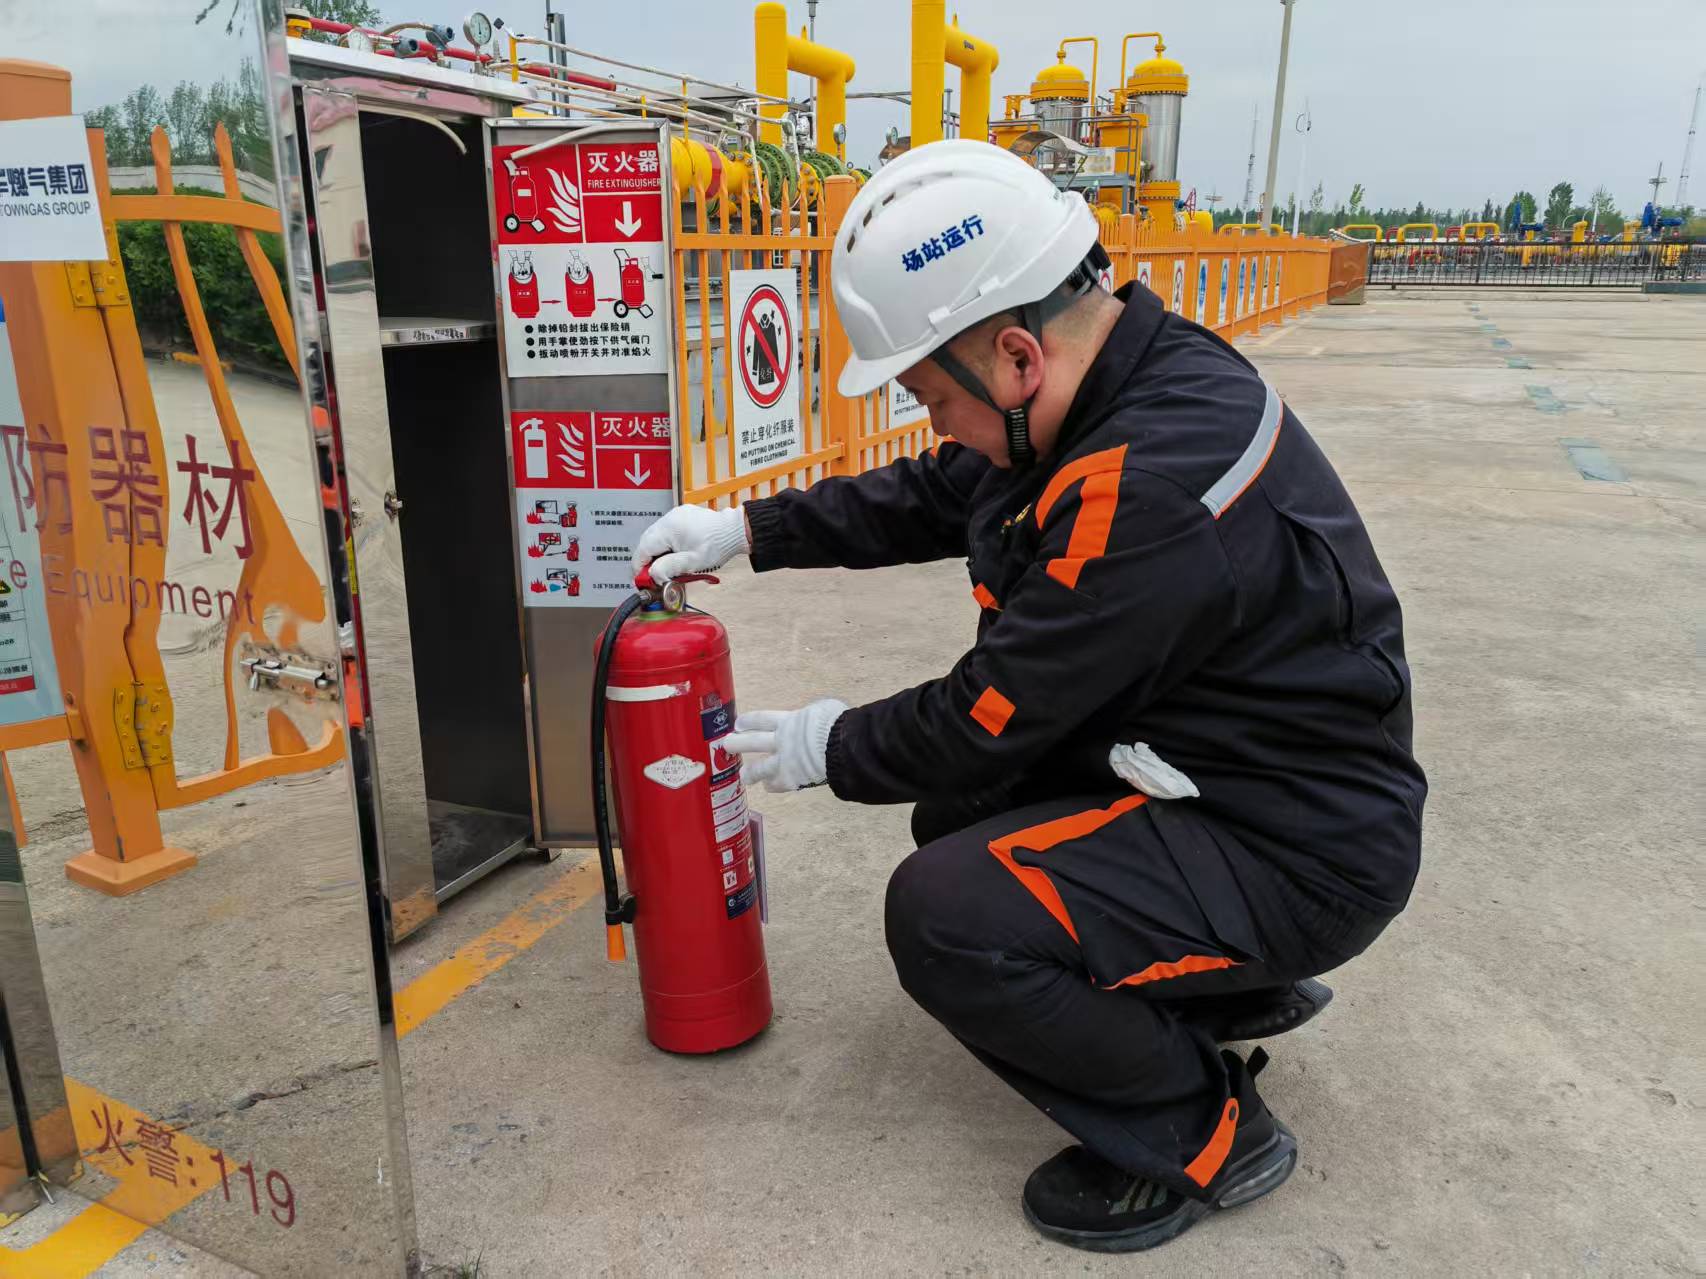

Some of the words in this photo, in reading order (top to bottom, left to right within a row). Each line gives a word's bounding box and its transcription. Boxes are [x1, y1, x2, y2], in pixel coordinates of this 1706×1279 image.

[587, 150, 659, 174] 灭火器
[587, 179, 605, 189] FIRE
[52, 201, 91, 215] GROUP
[901, 213, 985, 273] 场站运行
[537, 322, 631, 334] 除掉铅封拔出保险销
[538, 335, 650, 347] 用手掌使劲按下供气阀门
[601, 416, 671, 438] 灭火器
[741, 418, 794, 446] 禁止穿化纤服装
[740, 450, 748, 459] NO
[748, 445, 768, 457] PUTTING
[768, 443, 775, 452] ON
[774, 438, 796, 450] CHEMICAL
[750, 456, 764, 467] FIBRE
[46, 554, 255, 624] Equipment
